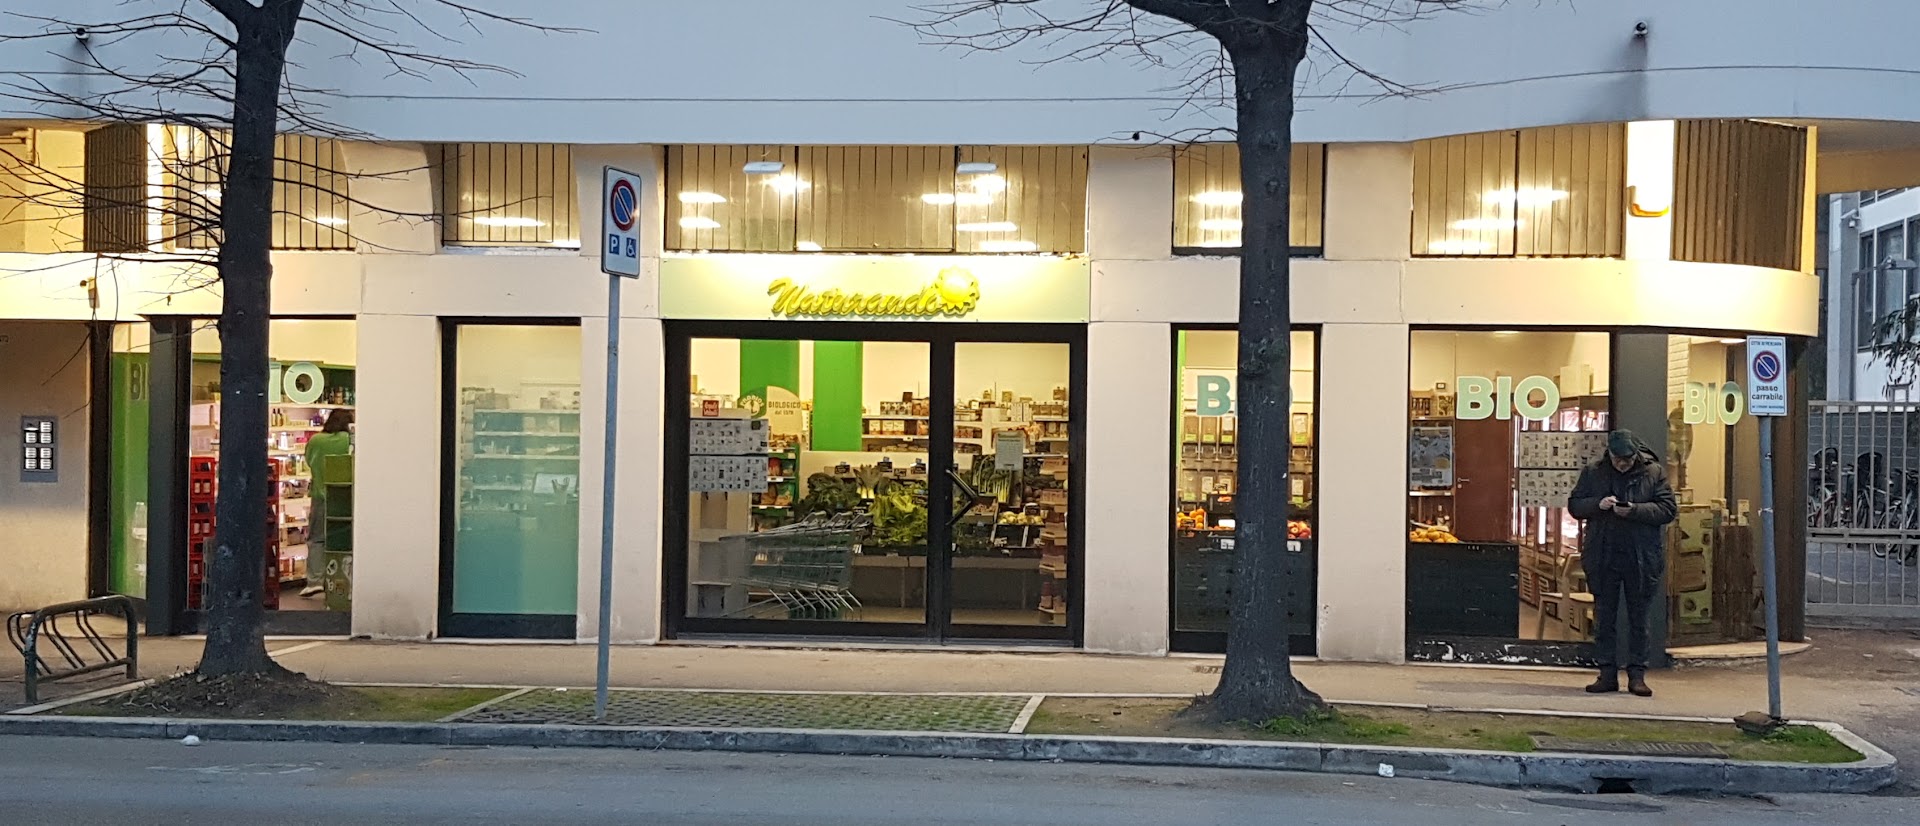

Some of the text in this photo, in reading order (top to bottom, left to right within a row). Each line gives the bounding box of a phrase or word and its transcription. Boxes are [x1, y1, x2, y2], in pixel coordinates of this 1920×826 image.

[611, 236, 618, 252] P
[768, 278, 941, 316] Naturando
[131, 363, 148, 400] BI
[269, 362, 325, 405] IO
[1456, 376, 1560, 421] BIO
[768, 401, 801, 409] BIOLOGICO
[1683, 381, 1744, 425] BIO
